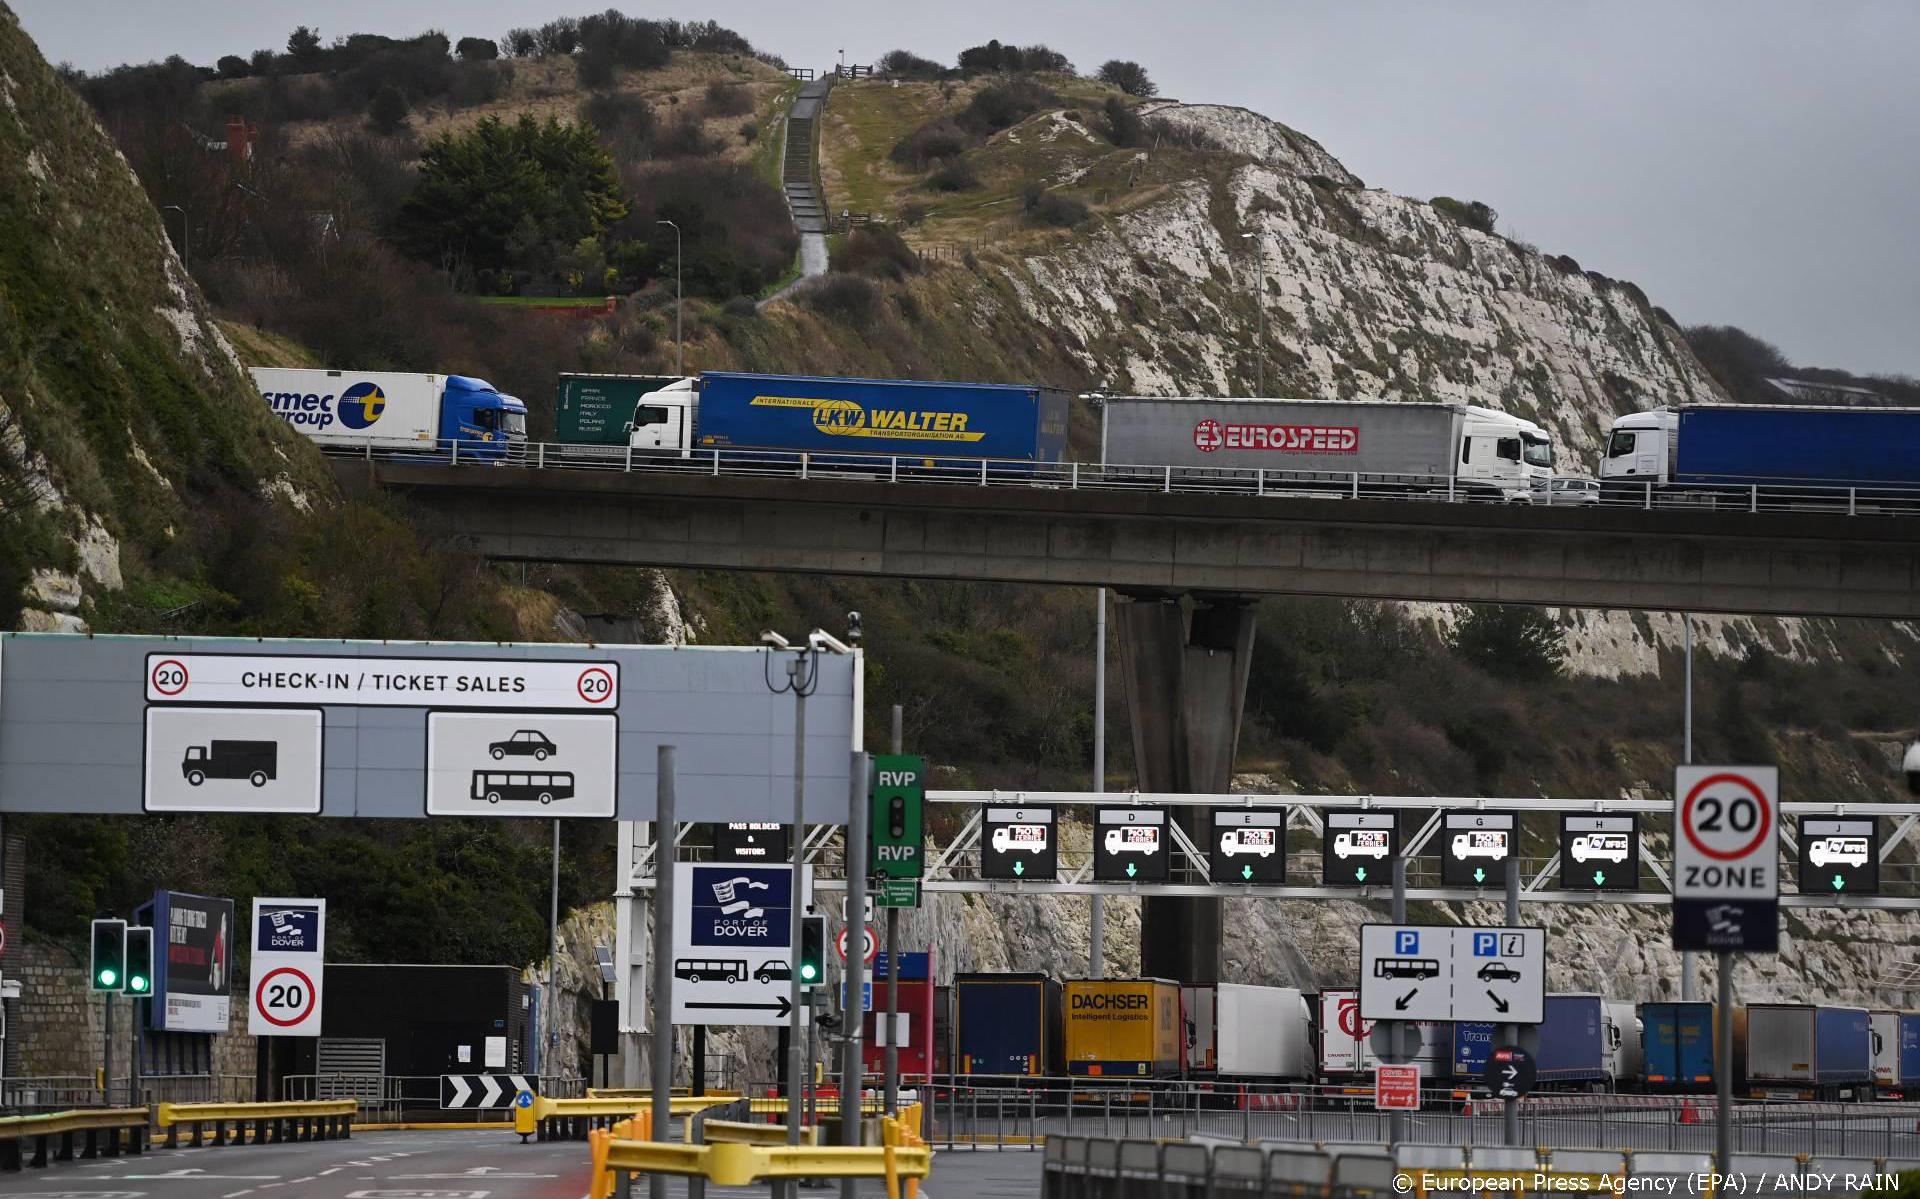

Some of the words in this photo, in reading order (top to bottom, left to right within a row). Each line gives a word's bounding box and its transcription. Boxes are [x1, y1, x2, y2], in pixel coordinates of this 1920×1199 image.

[756, 398, 815, 406] INTERNATIONALE
[815, 409, 863, 427] LKW
[870, 409, 969, 431] WALTER
[870, 429, 954, 438] TRANSPORTORGANISATION
[1226, 427, 1356, 449] EUROSPEED
[158, 670, 183, 685] 20
[241, 672, 350, 690] CHECK-IN
[357, 673, 365, 691] /
[372, 674, 448, 691] TICKET
[456, 676, 526, 693] SALES
[583, 679, 608, 693] 20
[879, 771, 916, 787] RVP
[1016, 811, 1023, 820] C
[1128, 813, 1135, 821] D
[1245, 815, 1251, 824] E
[1697, 798, 1758, 832] 20
[1358, 817, 1364, 825] F
[1476, 818, 1483, 826] G
[1596, 820, 1603, 829] H
[1836, 824, 1841, 832] J
[1128, 836, 1153, 844] FERRIES
[878, 846, 915, 861] RVP
[1685, 867, 1765, 887] ZONE
[714, 926, 768, 937] DOVER
[269, 985, 302, 1008] 20
[1072, 994, 1148, 1009] DACHSER
[1072, 1013, 1111, 1021] Intelligent
